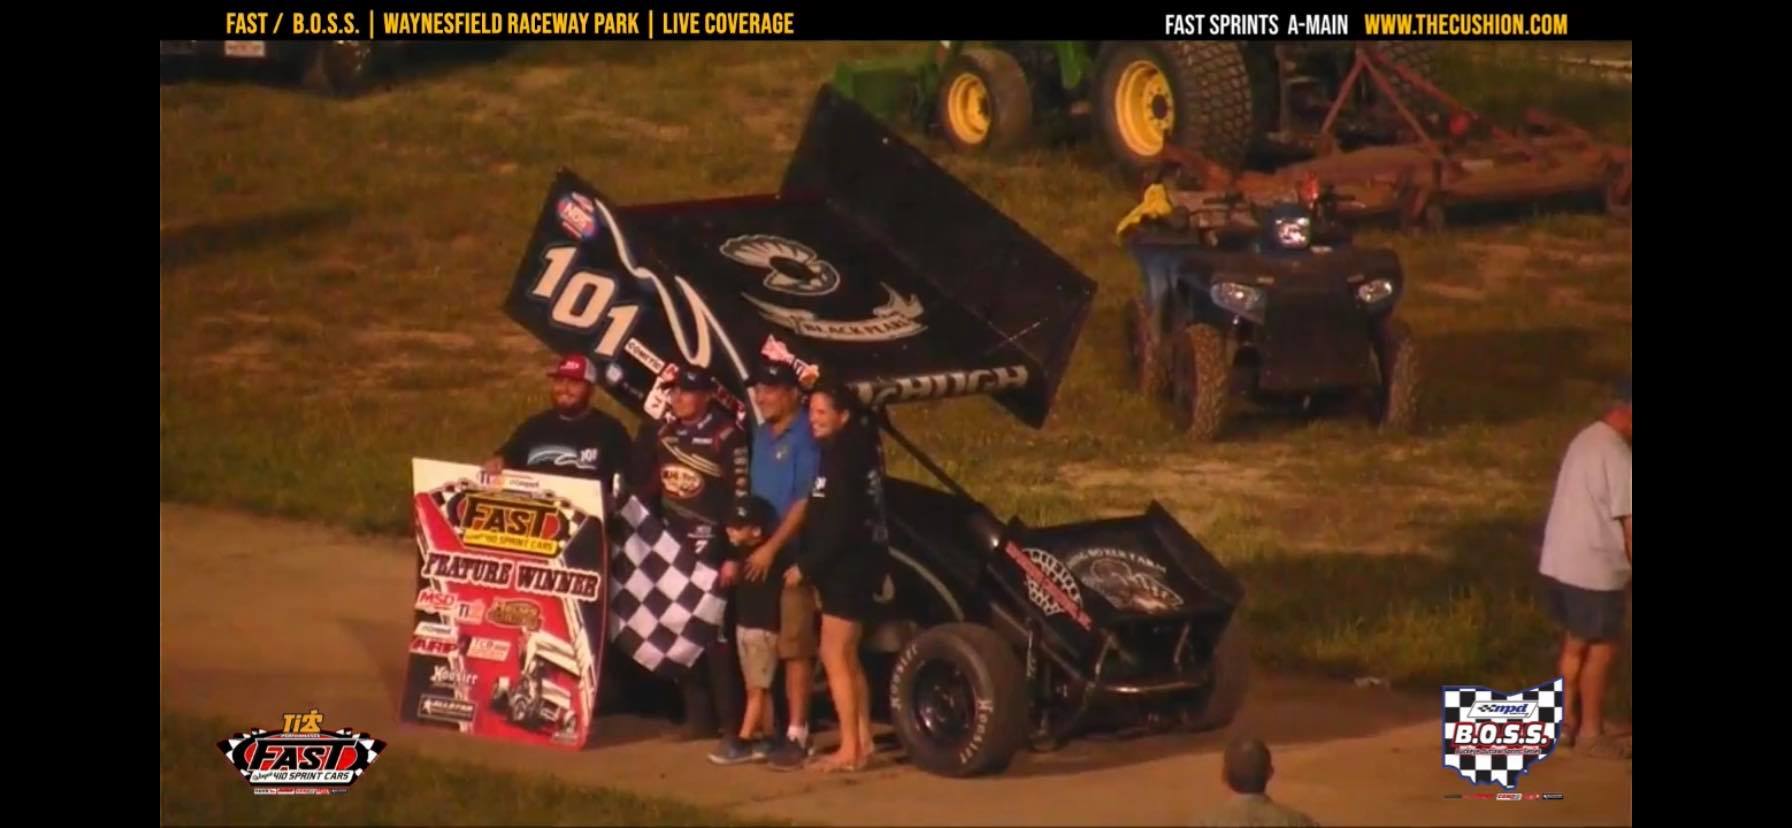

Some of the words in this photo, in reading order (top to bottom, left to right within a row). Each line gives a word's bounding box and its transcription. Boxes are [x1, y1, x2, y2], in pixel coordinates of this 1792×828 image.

[532, 247, 639, 356] 101
[462, 497, 559, 538] FAST
[423, 552, 514, 586] FEATURE
[516, 565, 600, 598] WINNER
